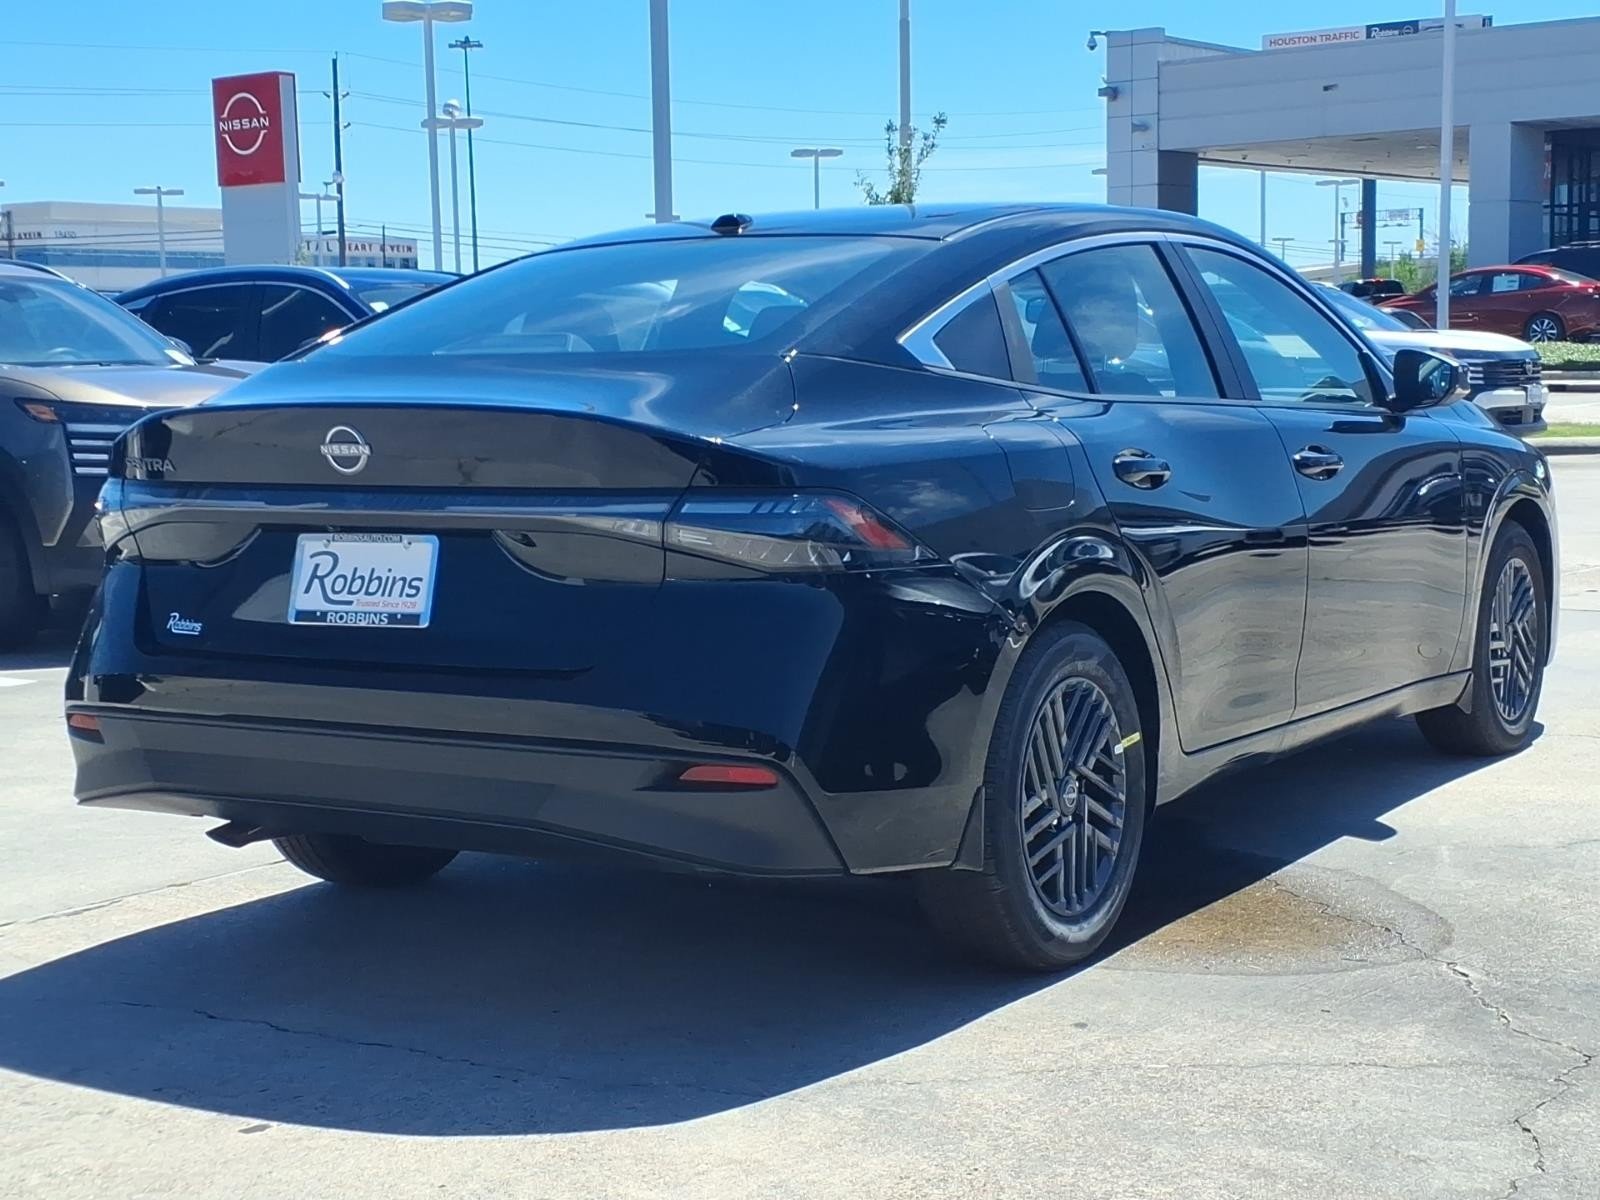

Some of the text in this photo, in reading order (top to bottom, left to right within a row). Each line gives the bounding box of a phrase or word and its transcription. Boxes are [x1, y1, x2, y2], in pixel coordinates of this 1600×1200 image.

[1269, 30, 1360, 47] HOUSTON TRAFFIC
[219, 116, 269, 131] NISSAN
[344, 241, 373, 252] EART
[390, 244, 413, 253] VEIN
[320, 444, 370, 456] NISSAN
[304, 550, 423, 606] Robbins
[381, 601, 400, 609] Since
[166, 612, 202, 635] Robbins
[327, 611, 388, 625] ROBBINS
